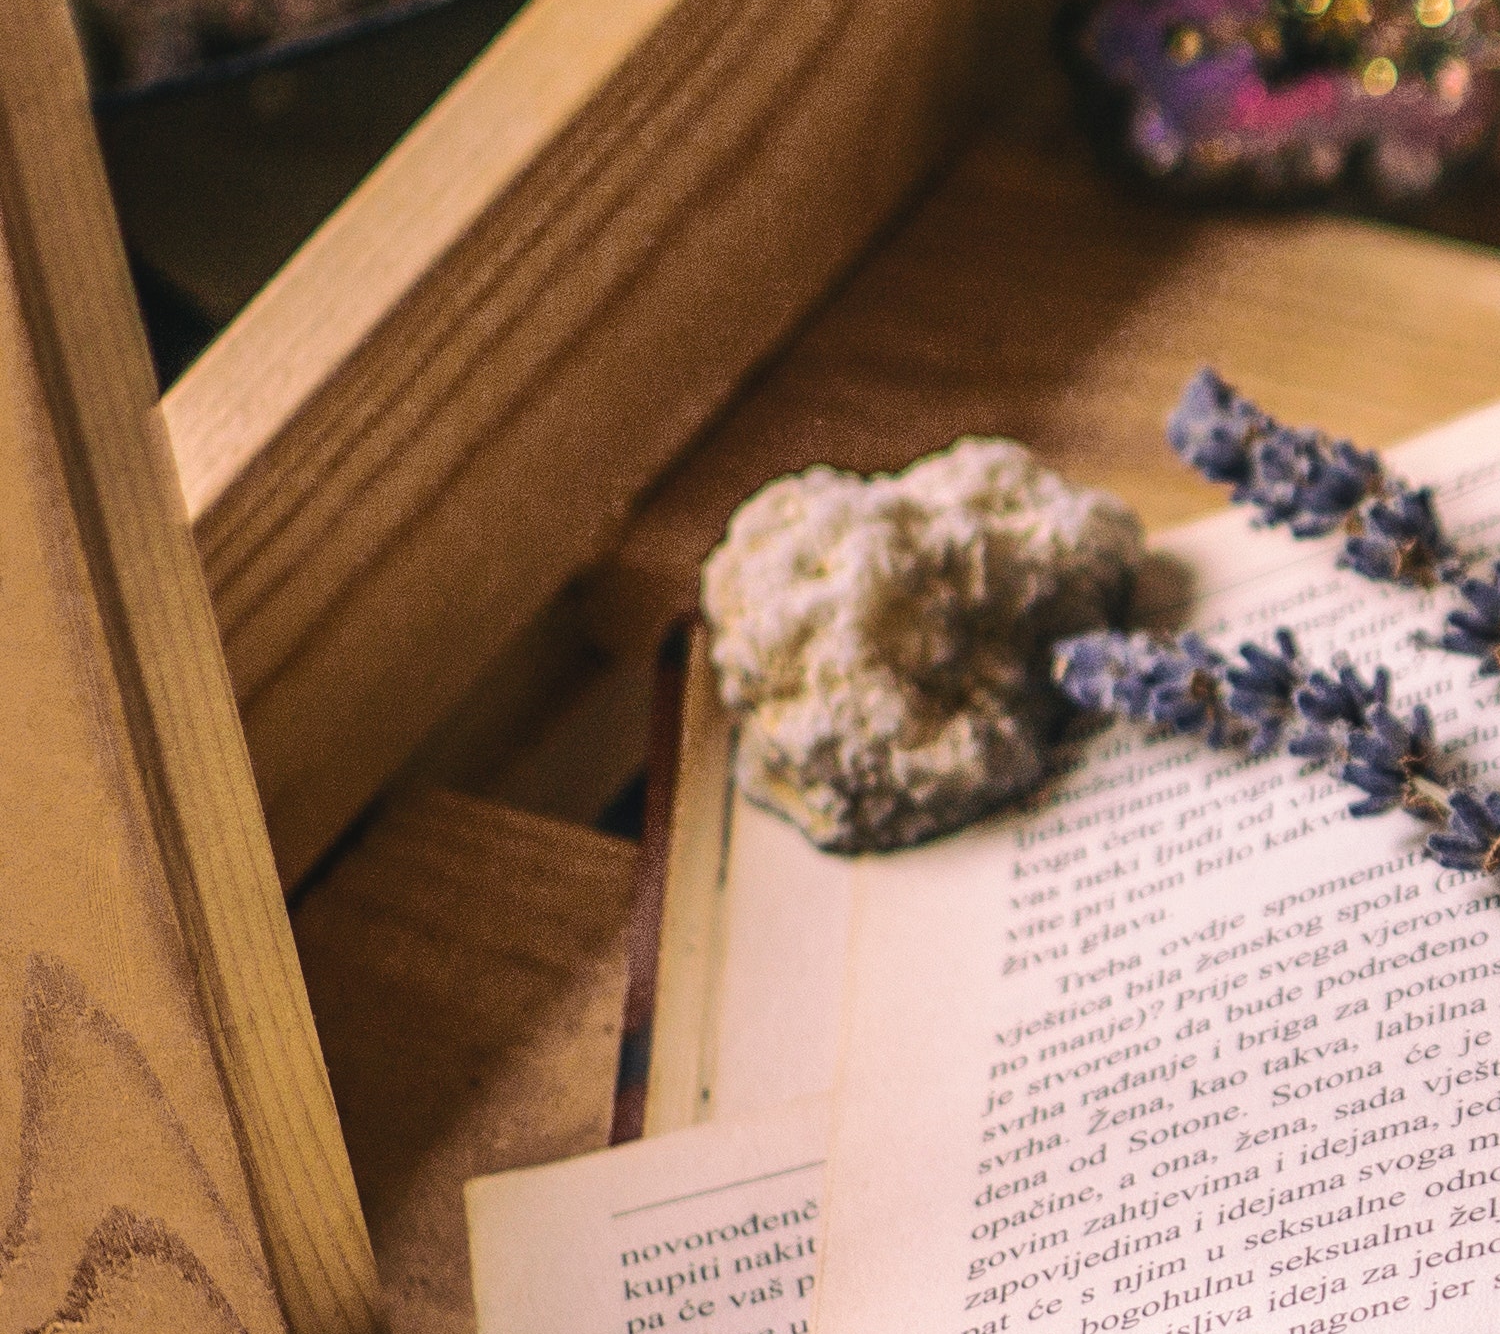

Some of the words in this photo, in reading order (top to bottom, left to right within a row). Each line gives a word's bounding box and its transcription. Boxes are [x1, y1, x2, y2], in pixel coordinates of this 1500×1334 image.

[623, 1256, 722, 1302] kupiti
[678, 1294, 716, 1322] će
[727, 1277, 784, 1309] vaš
[1424, 1279, 1475, 1310] jer
